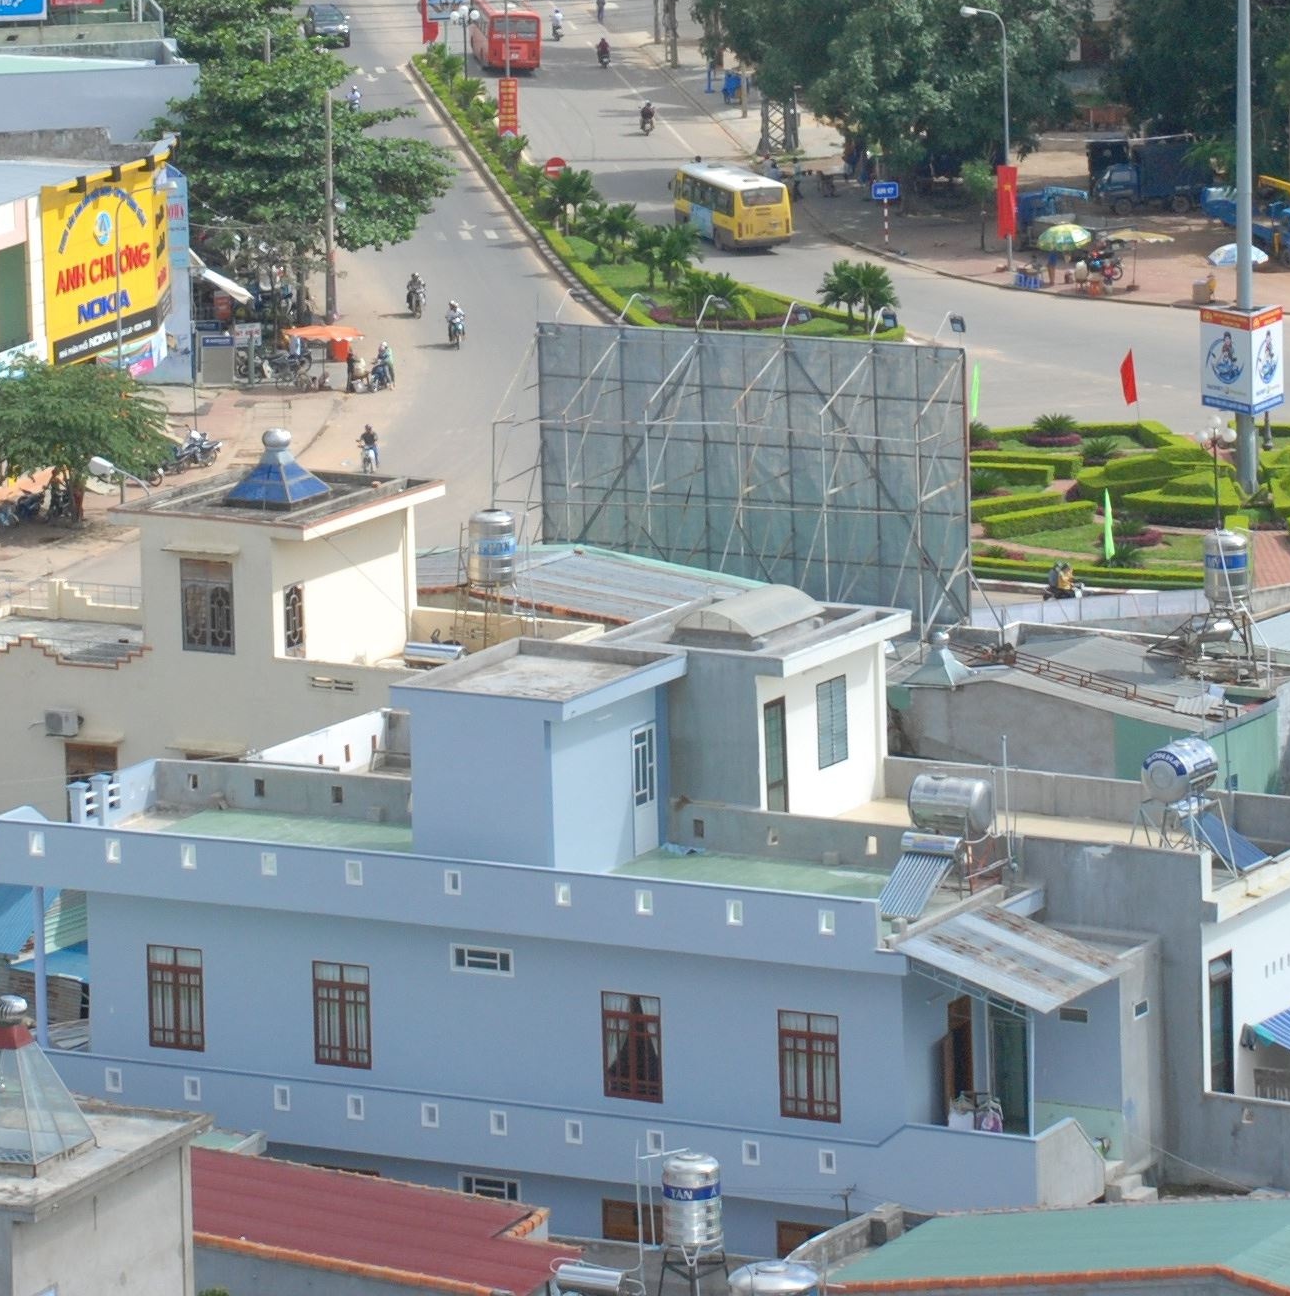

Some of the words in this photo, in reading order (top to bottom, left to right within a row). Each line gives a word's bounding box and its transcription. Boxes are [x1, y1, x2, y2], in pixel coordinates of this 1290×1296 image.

[56, 266, 87, 296] ANH
[78, 289, 131, 325] NOKIA
[671, 1189, 693, 1200] TAN
